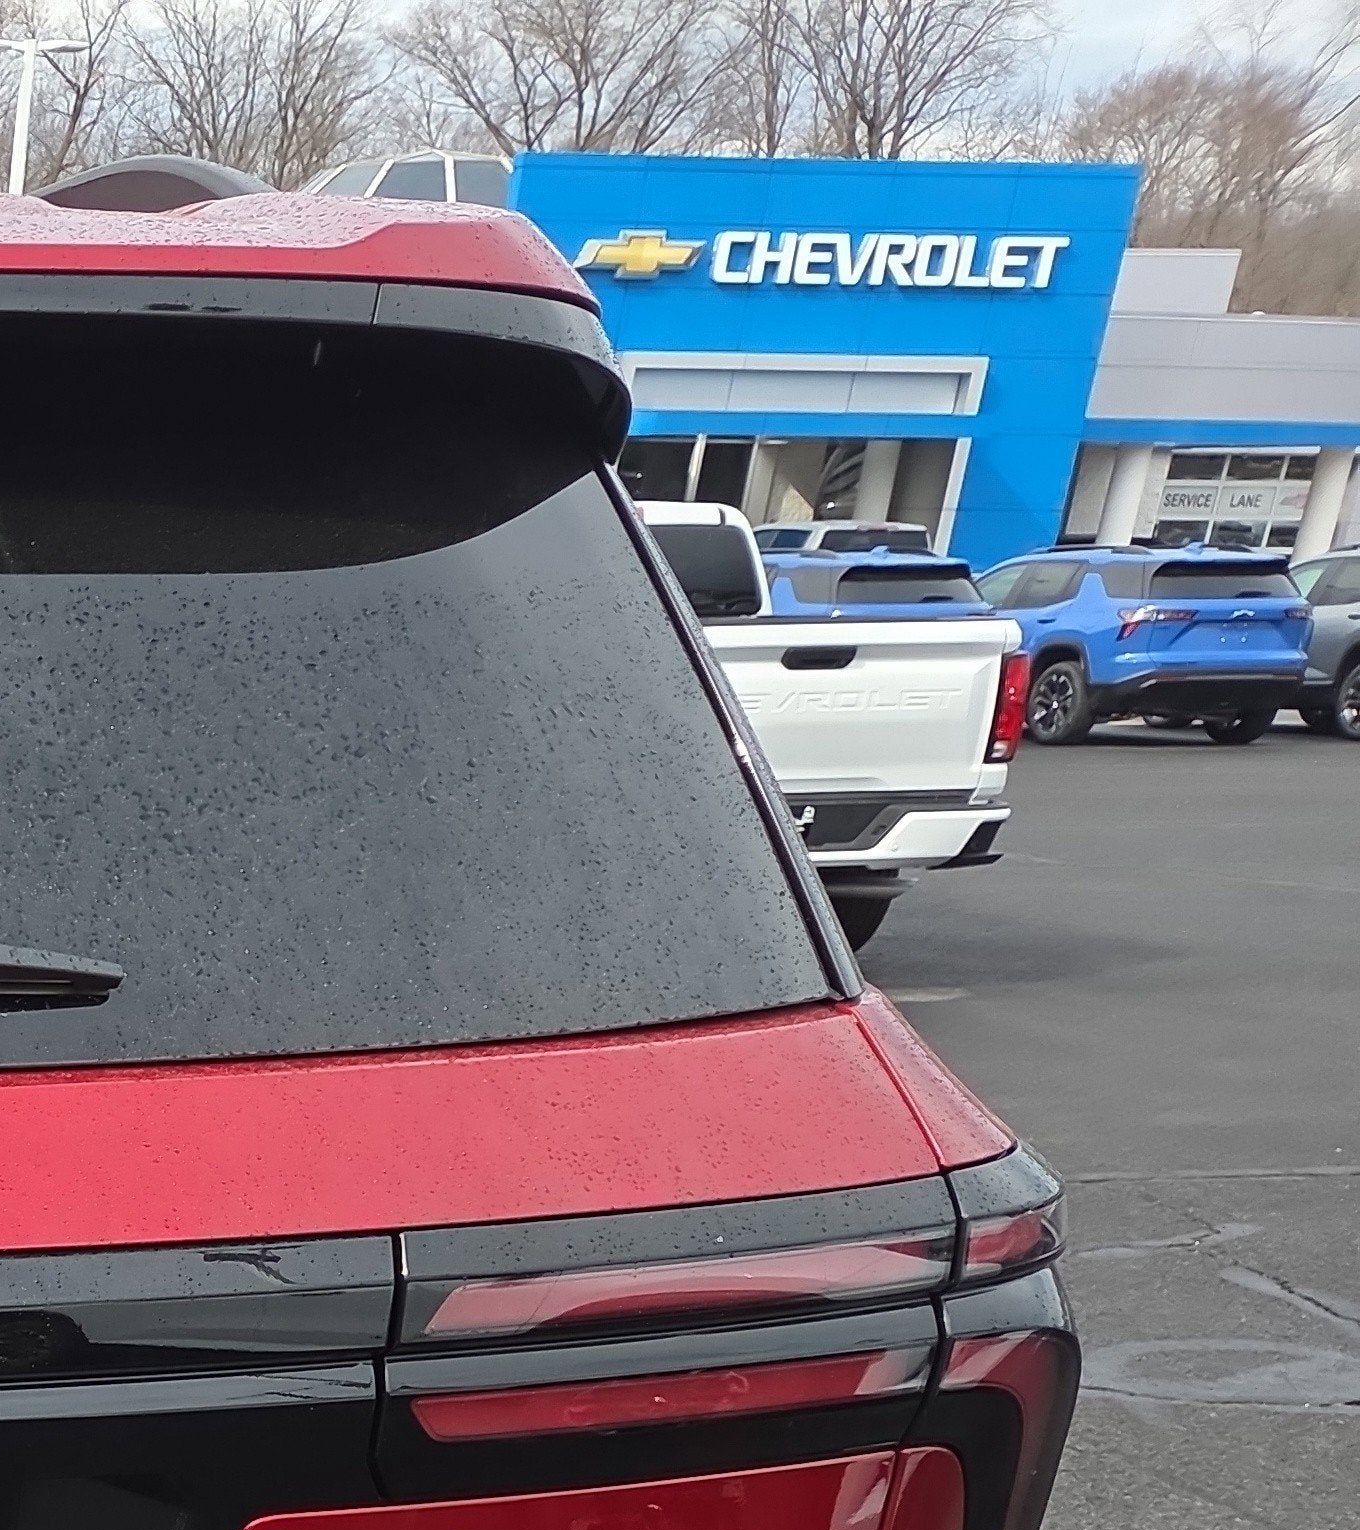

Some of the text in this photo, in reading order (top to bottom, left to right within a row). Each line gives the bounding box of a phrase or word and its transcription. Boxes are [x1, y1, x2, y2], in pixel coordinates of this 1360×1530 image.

[711, 230, 1071, 289] CHEVROLET
[1162, 492, 1263, 509] SERVICE LANE
[737, 686, 963, 713] EVROLET
